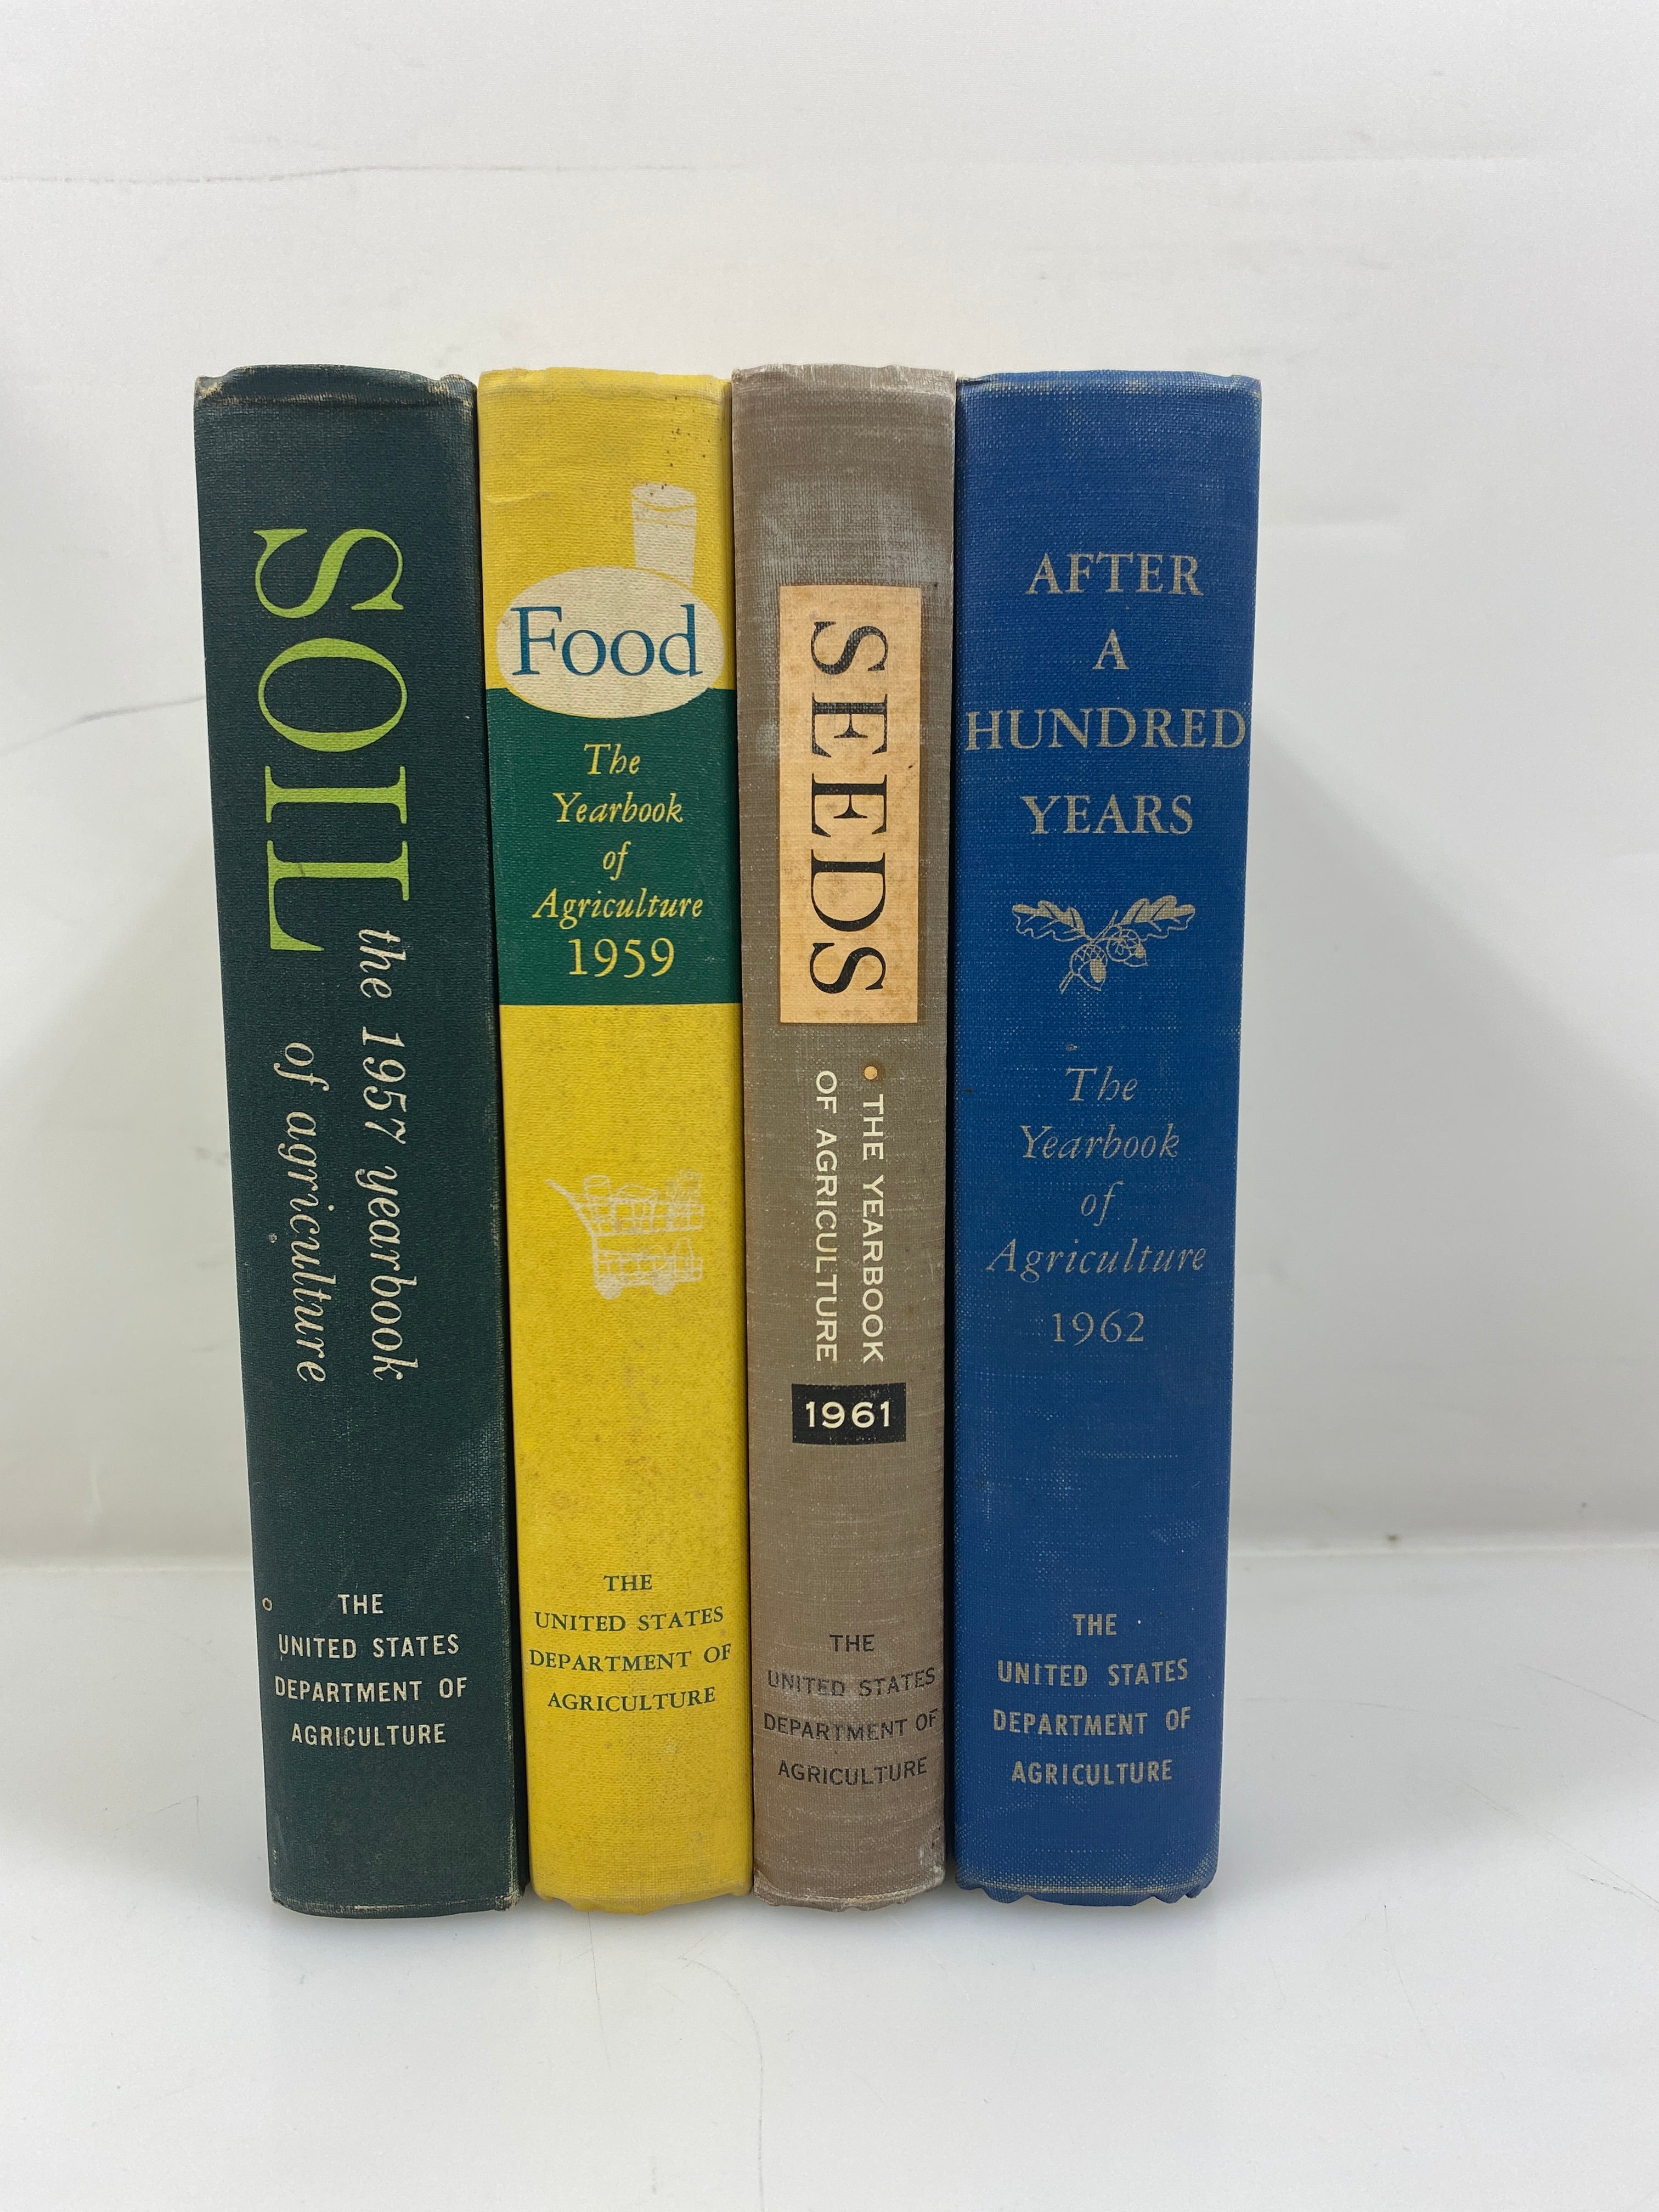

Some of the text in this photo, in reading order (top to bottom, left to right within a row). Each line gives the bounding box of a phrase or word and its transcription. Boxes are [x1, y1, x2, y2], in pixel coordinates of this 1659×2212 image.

[1025, 553, 1204, 596] AFTER
[510, 604, 703, 677] Food
[1092, 628, 1130, 670] A
[253, 528, 409, 951] SOIL
[964, 707, 1247, 751] HUNDRED
[583, 743, 640, 776] The
[553, 791, 684, 825] Yearbook
[809, 621, 889, 994] SEEDS
[1021, 793, 1194, 835] YEARS
[601, 842, 630, 881] of
[532, 888, 704, 931] Agriculture
[568, 938, 675, 979] 1959
[1065, 1065, 1138, 1102] The
[355, 928, 418, 1381] the 1957 yearbook
[1020, 1123, 1180, 1159] Yearbook
[273, 1041, 337, 1383] of agriculture
[816, 1070, 838, 1362] OF AGRICULTURE
[1081, 1181, 1124, 1227] of
[862, 1094, 884, 1364] THE YEARBOOK
[986, 1238, 1206, 1283] Agriculture
[1052, 1309, 1144, 1346] 1962
[806, 1401, 890, 1429] 1961
[603, 1575, 652, 1592] THE
[337, 1594, 383, 1615] THE
[534, 1606, 724, 1632] UNITED STATES
[1073, 1613, 1117, 1636] THE
[278, 1634, 459, 1658] UNITED STATES
[529, 1644, 731, 1672] DEPARTMENT OF
[829, 1634, 874, 1652] THE
[275, 1676, 467, 1703] DEPARTMENT OF
[768, 1667, 935, 1696] UNITED STATES
[997, 1658, 1188, 1686] UNITED STATES
[548, 1687, 715, 1712] AGRICULTURE
[291, 1723, 446, 1747] AGRICULTURE
[764, 1708, 938, 1741] DEPARTMENT OF
[993, 1706, 1191, 1736] DEPARTMENT OF
[778, 1757, 927, 1785] AGRICULTURE
[1012, 1759, 1172, 1786] AGRICULTURE
